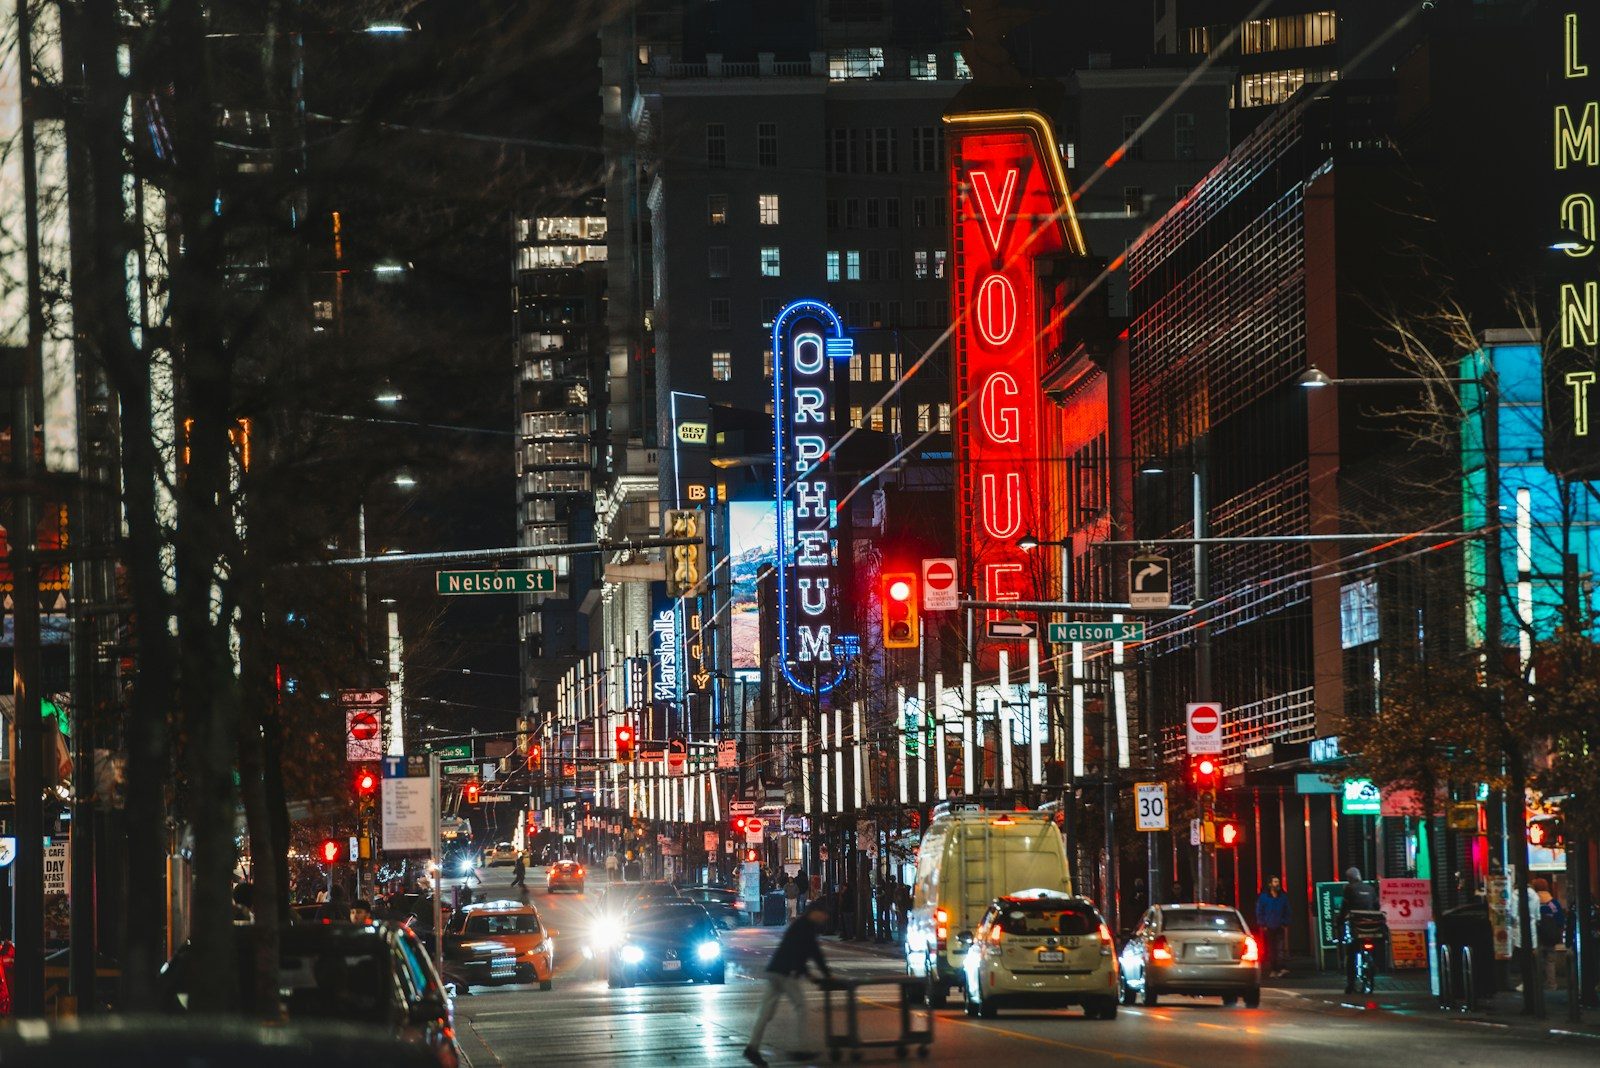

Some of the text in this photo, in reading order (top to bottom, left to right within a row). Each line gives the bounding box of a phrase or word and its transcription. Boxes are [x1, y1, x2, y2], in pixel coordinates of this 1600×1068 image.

[1554, 14, 1599, 436] LMONT
[969, 169, 1022, 622] VOGUE
[793, 332, 831, 661] ORPHEUM
[449, 573, 543, 591] Nelson St
[1057, 625, 1137, 640] Nelson St
[653, 609, 676, 700] Marshalls
[1140, 797, 1163, 817] 30
[46, 860, 65, 872] DAY
[48, 848, 65, 857] CAFE
[1322, 890, 1333, 941] SHOT SPECIAL
